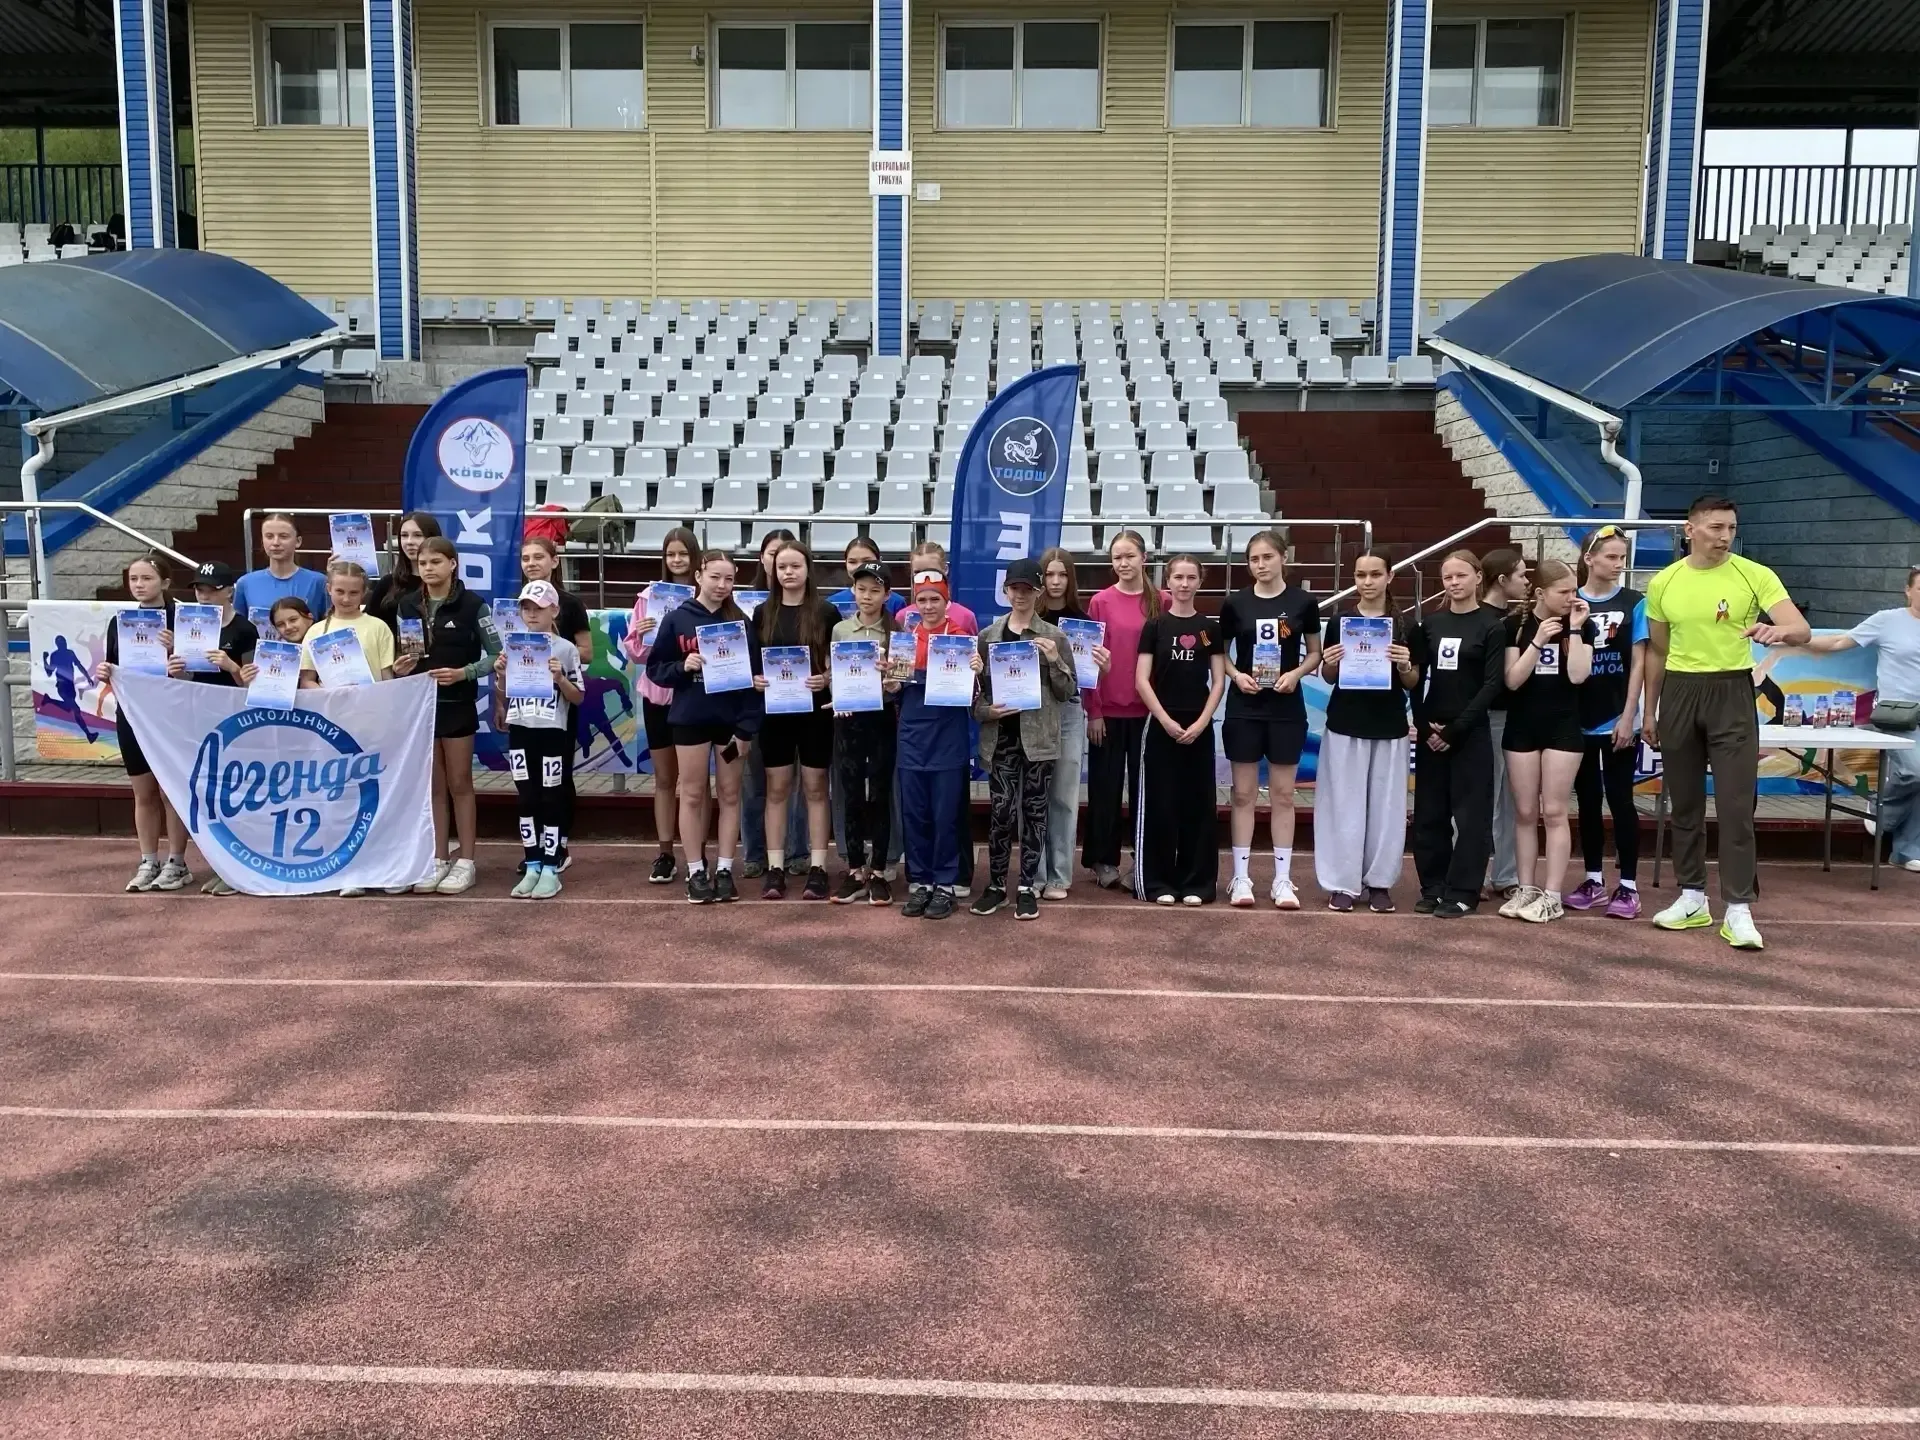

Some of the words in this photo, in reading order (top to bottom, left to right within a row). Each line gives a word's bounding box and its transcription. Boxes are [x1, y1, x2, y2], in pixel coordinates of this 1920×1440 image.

[871, 161, 910, 172] ЦЕНТРАЛЬНАЯ
[878, 175, 903, 185] ТРИБУНА
[994, 466, 1046, 482] ТОДОШ
[526, 585, 544, 597] 12
[1261, 623, 1275, 640] 8
[1172, 636, 1178, 646] I
[1171, 649, 1195, 660] ME
[1540, 648, 1555, 665] 8
[237, 710, 340, 740] ШКОЛЬНЫЙ
[510, 753, 525, 770] 12
[544, 761, 560, 776] 12
[189, 731, 387, 834] Легенда
[270, 808, 324, 858] 12
[520, 823, 532, 839] 5
[229, 841, 341, 879] СПОРТИВНЫЙ
[347, 811, 372, 852] КЛУБ
[544, 832, 555, 848] 5
